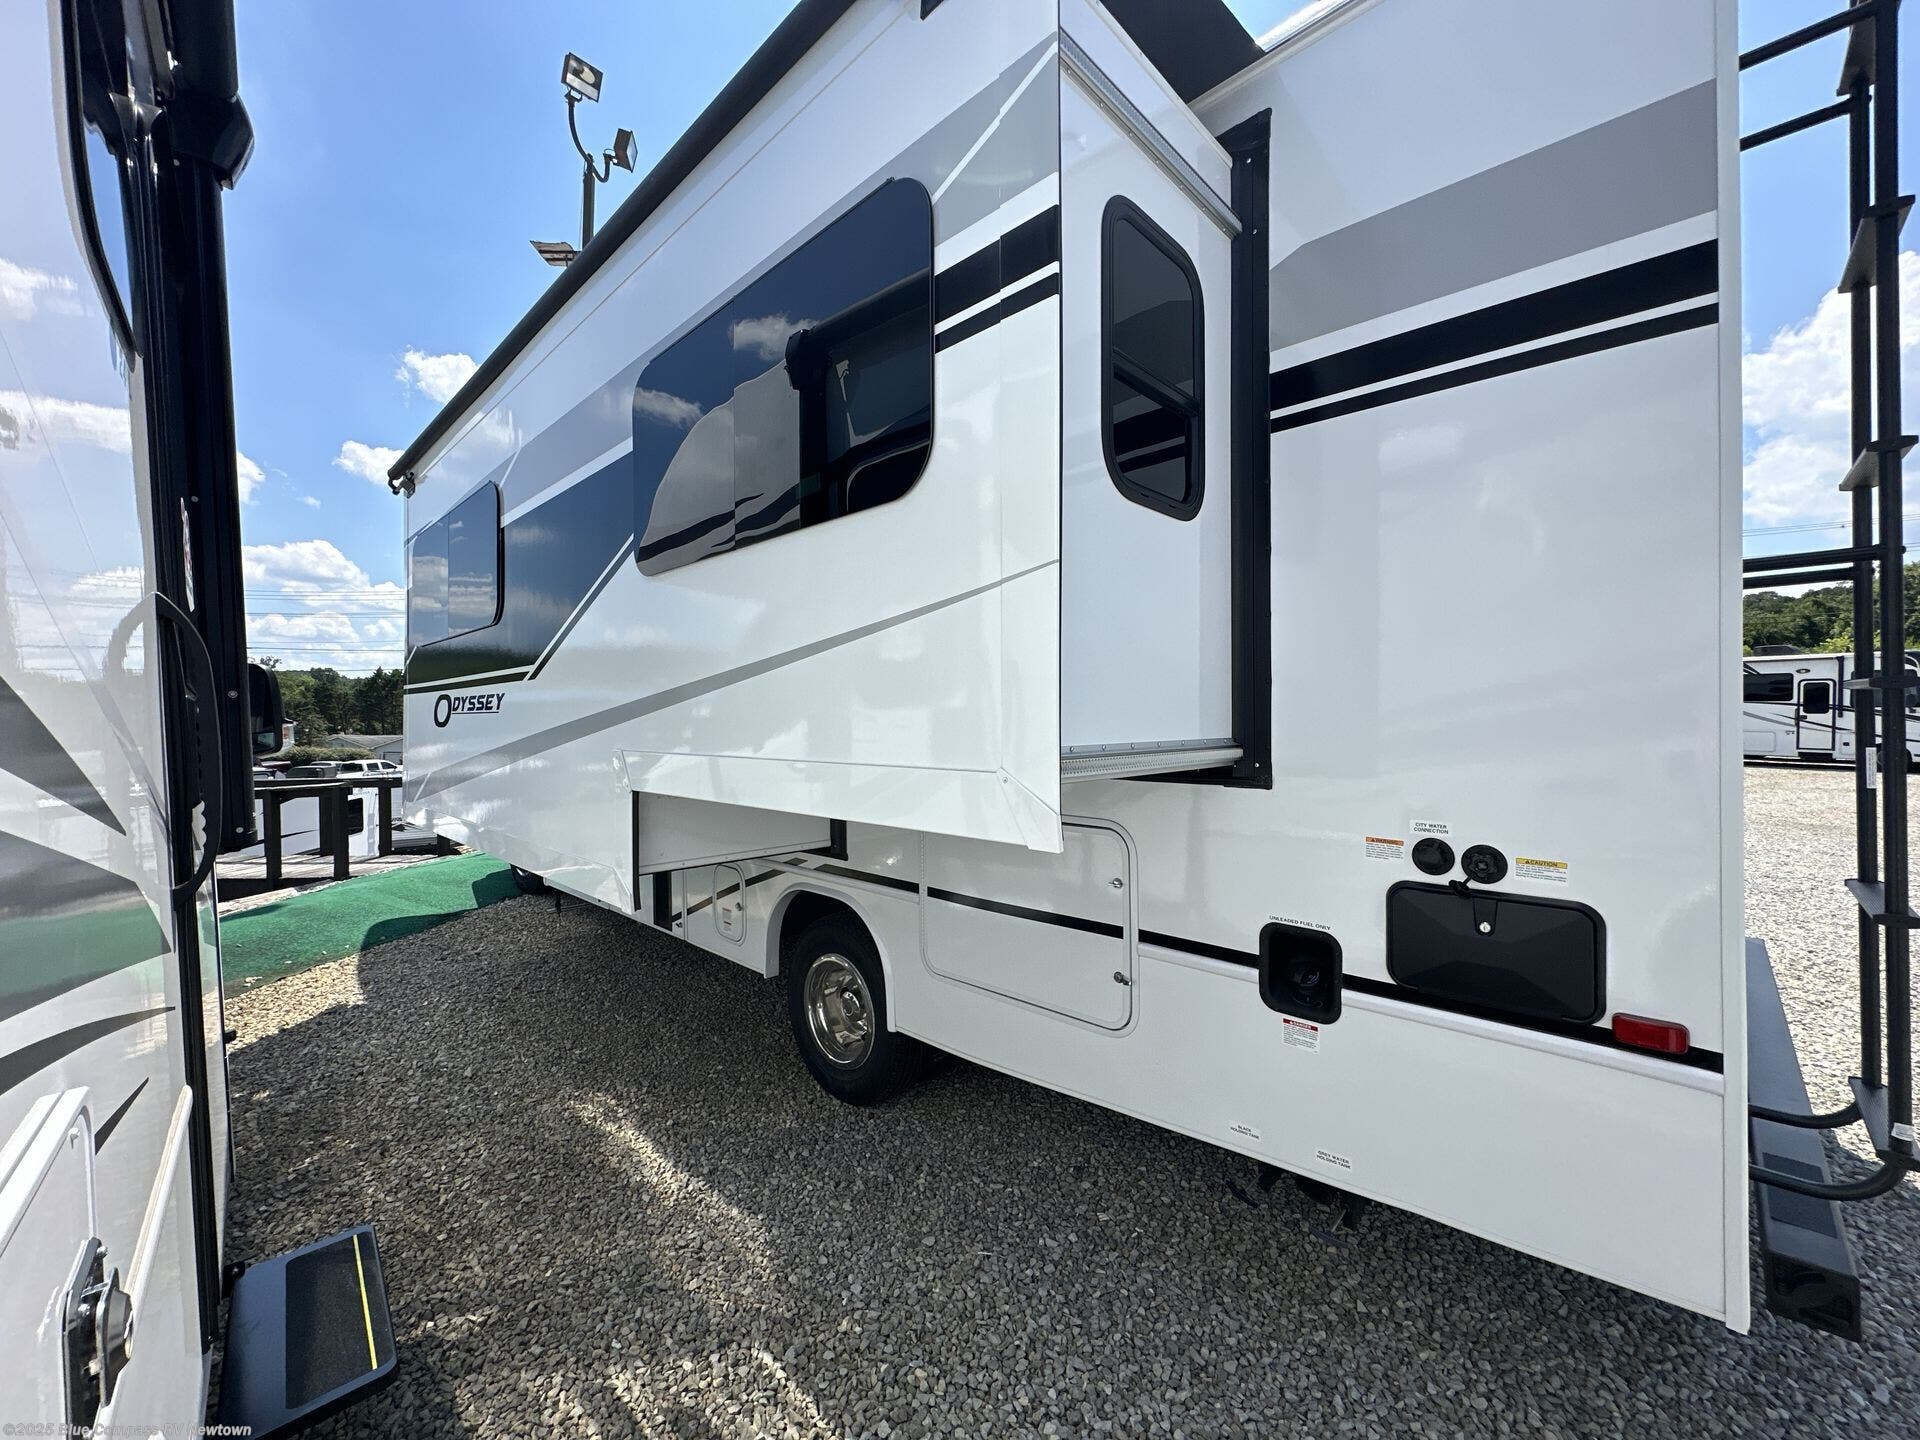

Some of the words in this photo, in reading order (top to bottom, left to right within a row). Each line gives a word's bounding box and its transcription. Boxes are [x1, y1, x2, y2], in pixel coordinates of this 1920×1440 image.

[434, 693, 506, 728] ODYSSEY
[1413, 827, 1449, 835] CONNECTION
[1530, 859, 1558, 868] CAUTION
[1269, 915, 1299, 925] UNLEADED
[1300, 920, 1314, 928] FUEL
[1315, 923, 1331, 931] ONLY
[1230, 1126, 1248, 1136] HOLDING
[1248, 1132, 1260, 1140] TANK
[1237, 1124, 1252, 1132] BLACK
[1316, 1155, 1338, 1165] HOLDING
[1338, 1161, 1351, 1169] TANK
[1331, 1155, 1349, 1164] WATER
